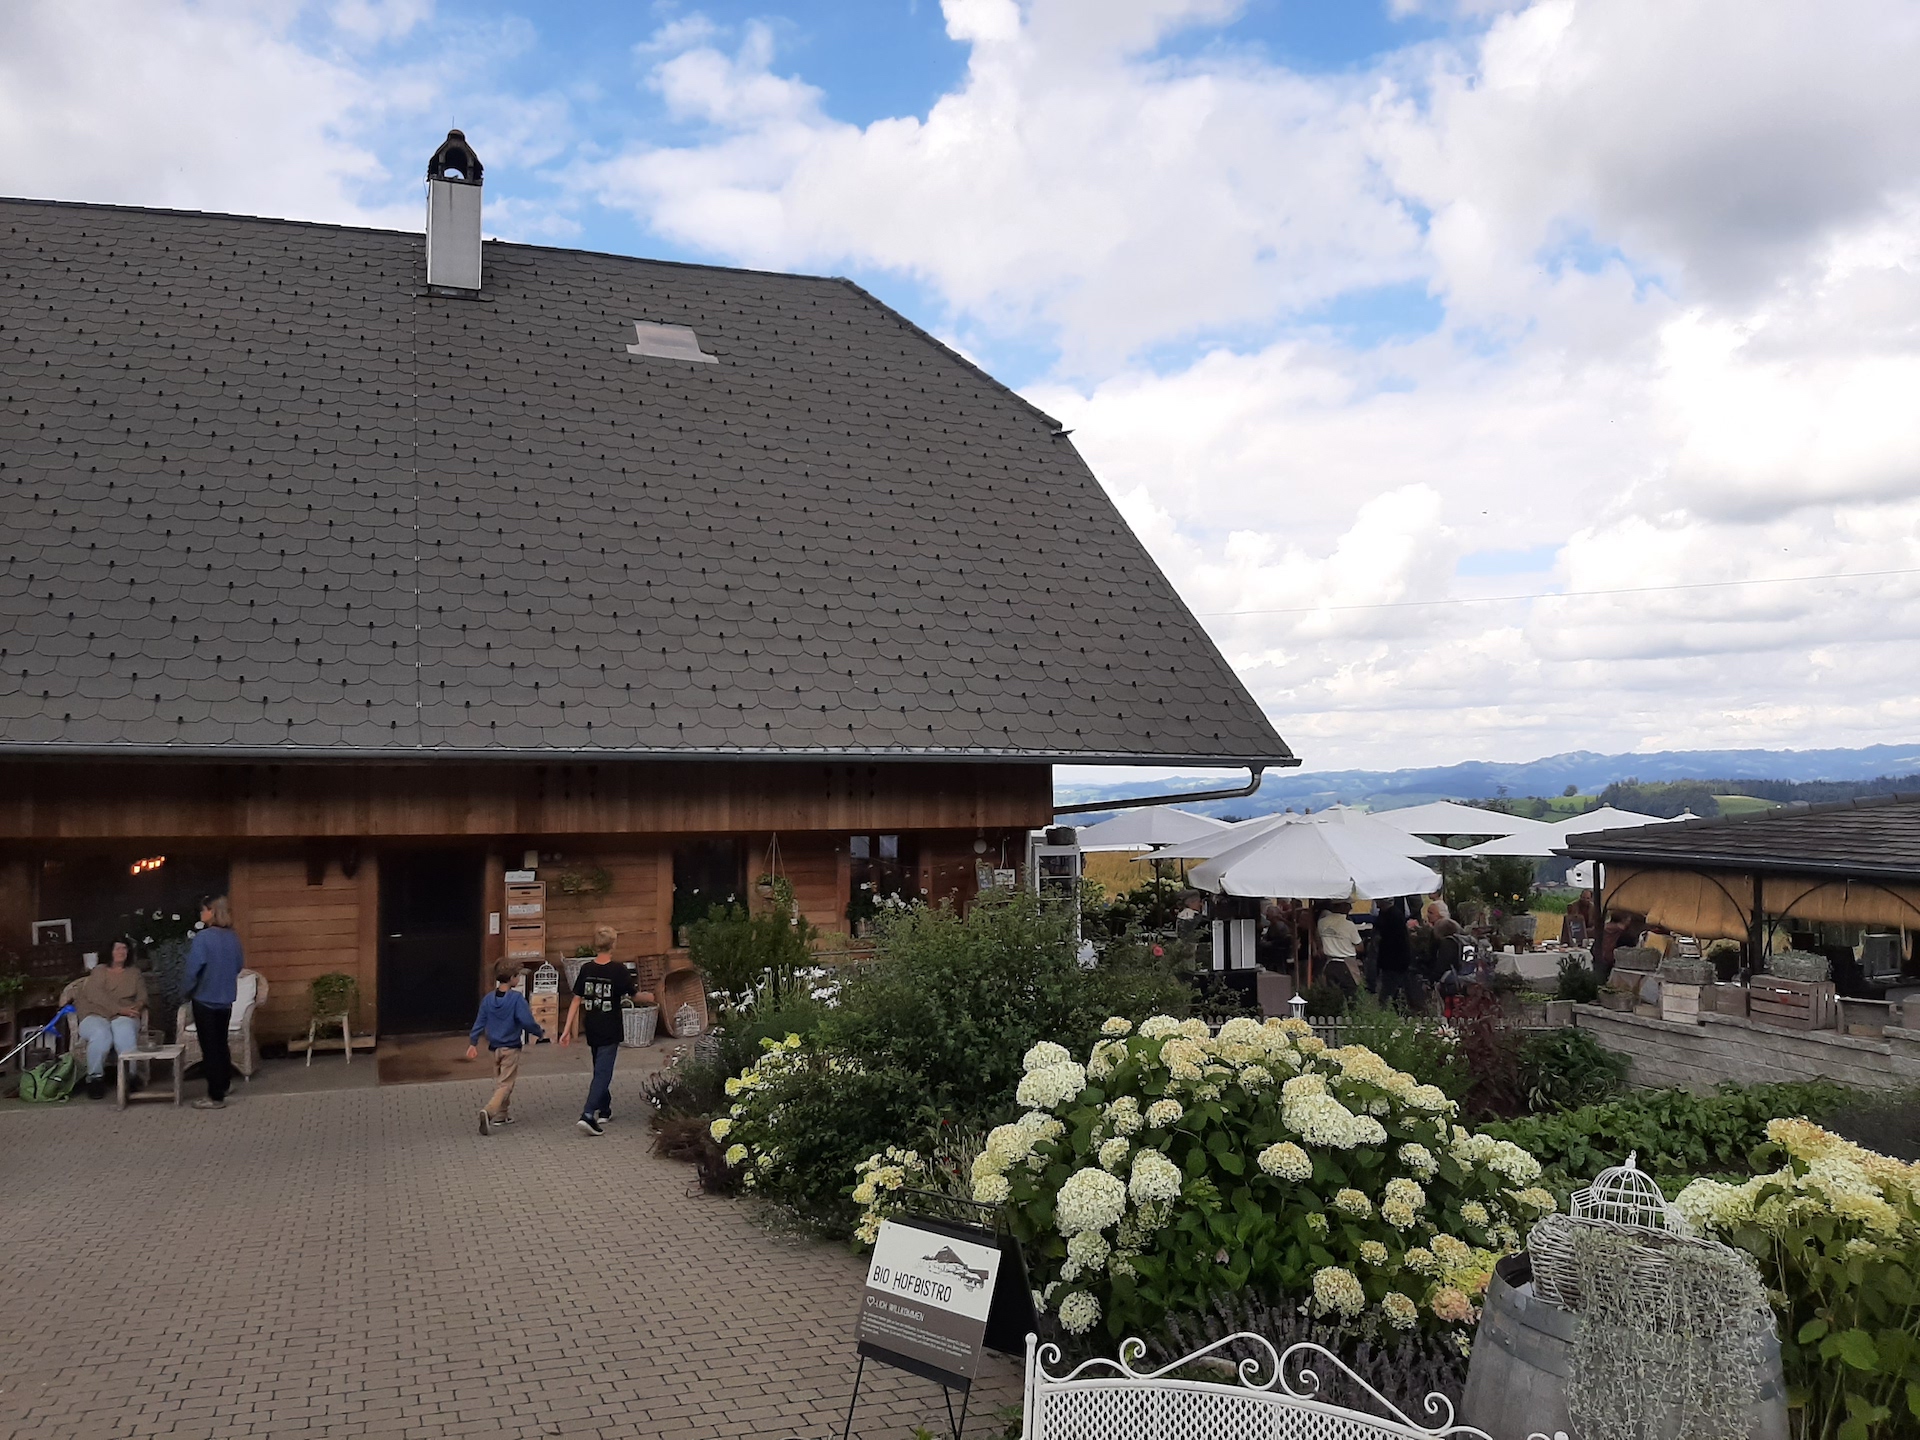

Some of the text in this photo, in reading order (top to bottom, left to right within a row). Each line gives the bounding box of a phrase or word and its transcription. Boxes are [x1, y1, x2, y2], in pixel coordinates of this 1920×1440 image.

[873, 1265, 952, 1303] BIO HOFBISTRO
[888, 1303, 925, 1322] WILLKOMMEN
